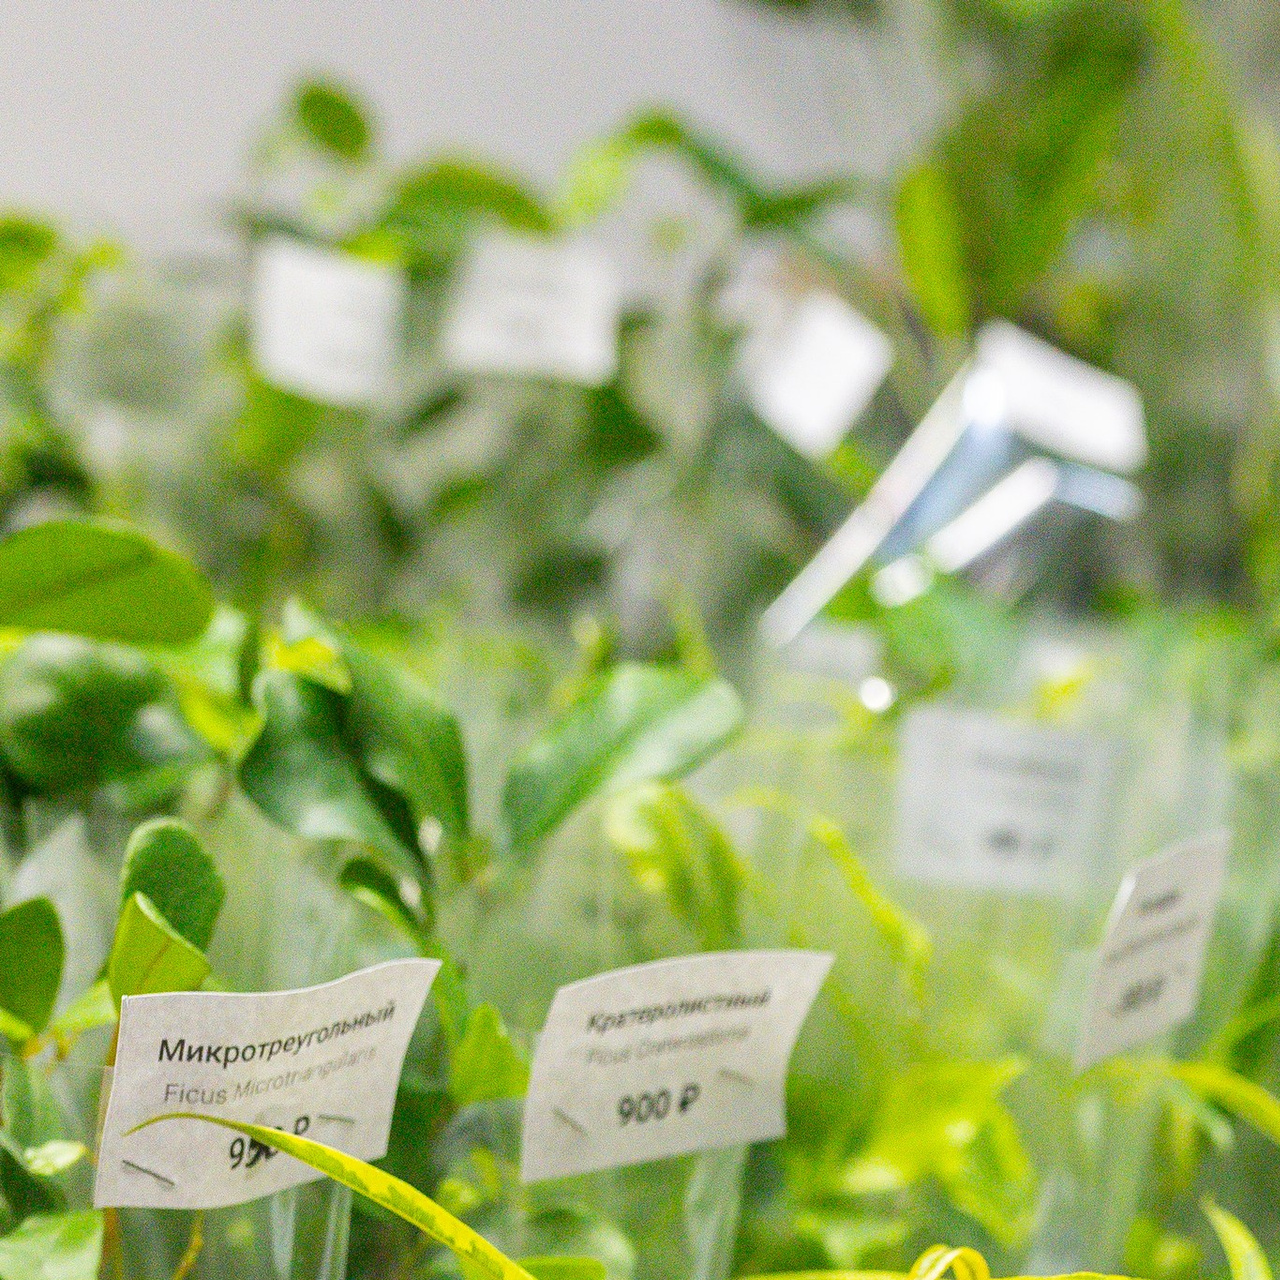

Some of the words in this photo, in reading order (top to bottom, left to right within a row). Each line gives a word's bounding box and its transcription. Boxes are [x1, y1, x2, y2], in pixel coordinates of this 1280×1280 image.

[157, 1000, 396, 1068] Микротреугольный
[164, 1083, 228, 1106] Ficus
[617, 1086, 672, 1127] 900
